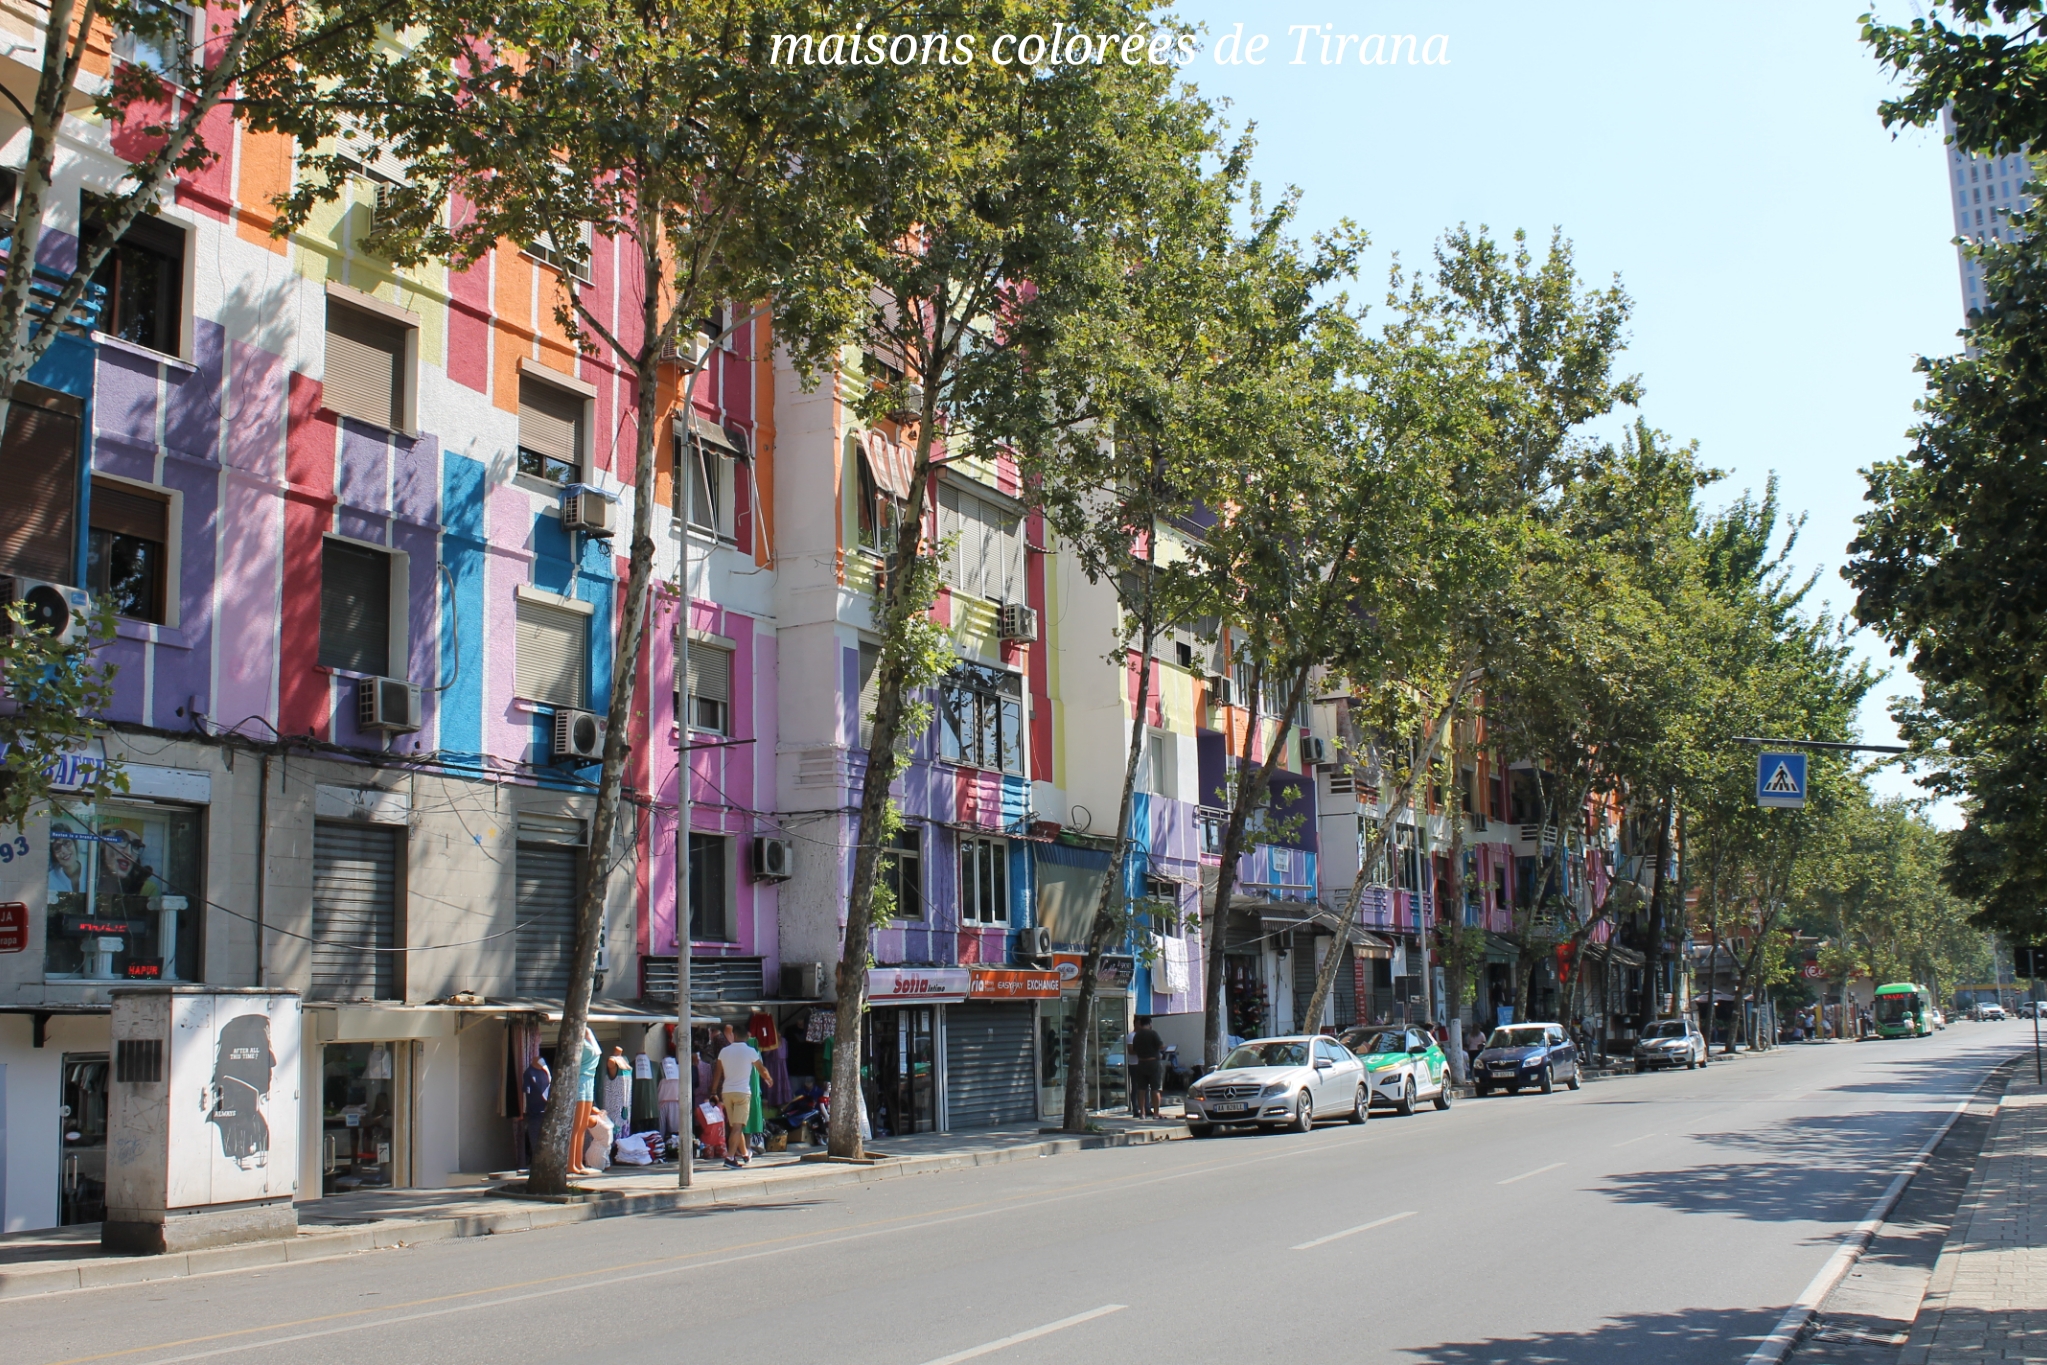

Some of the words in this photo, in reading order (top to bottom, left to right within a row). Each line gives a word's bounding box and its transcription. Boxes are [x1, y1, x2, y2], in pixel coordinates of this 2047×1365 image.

[128, 965, 158, 975] HAPUR
[971, 974, 984, 992] ria
[1026, 979, 1059, 991] EXCHANGE
